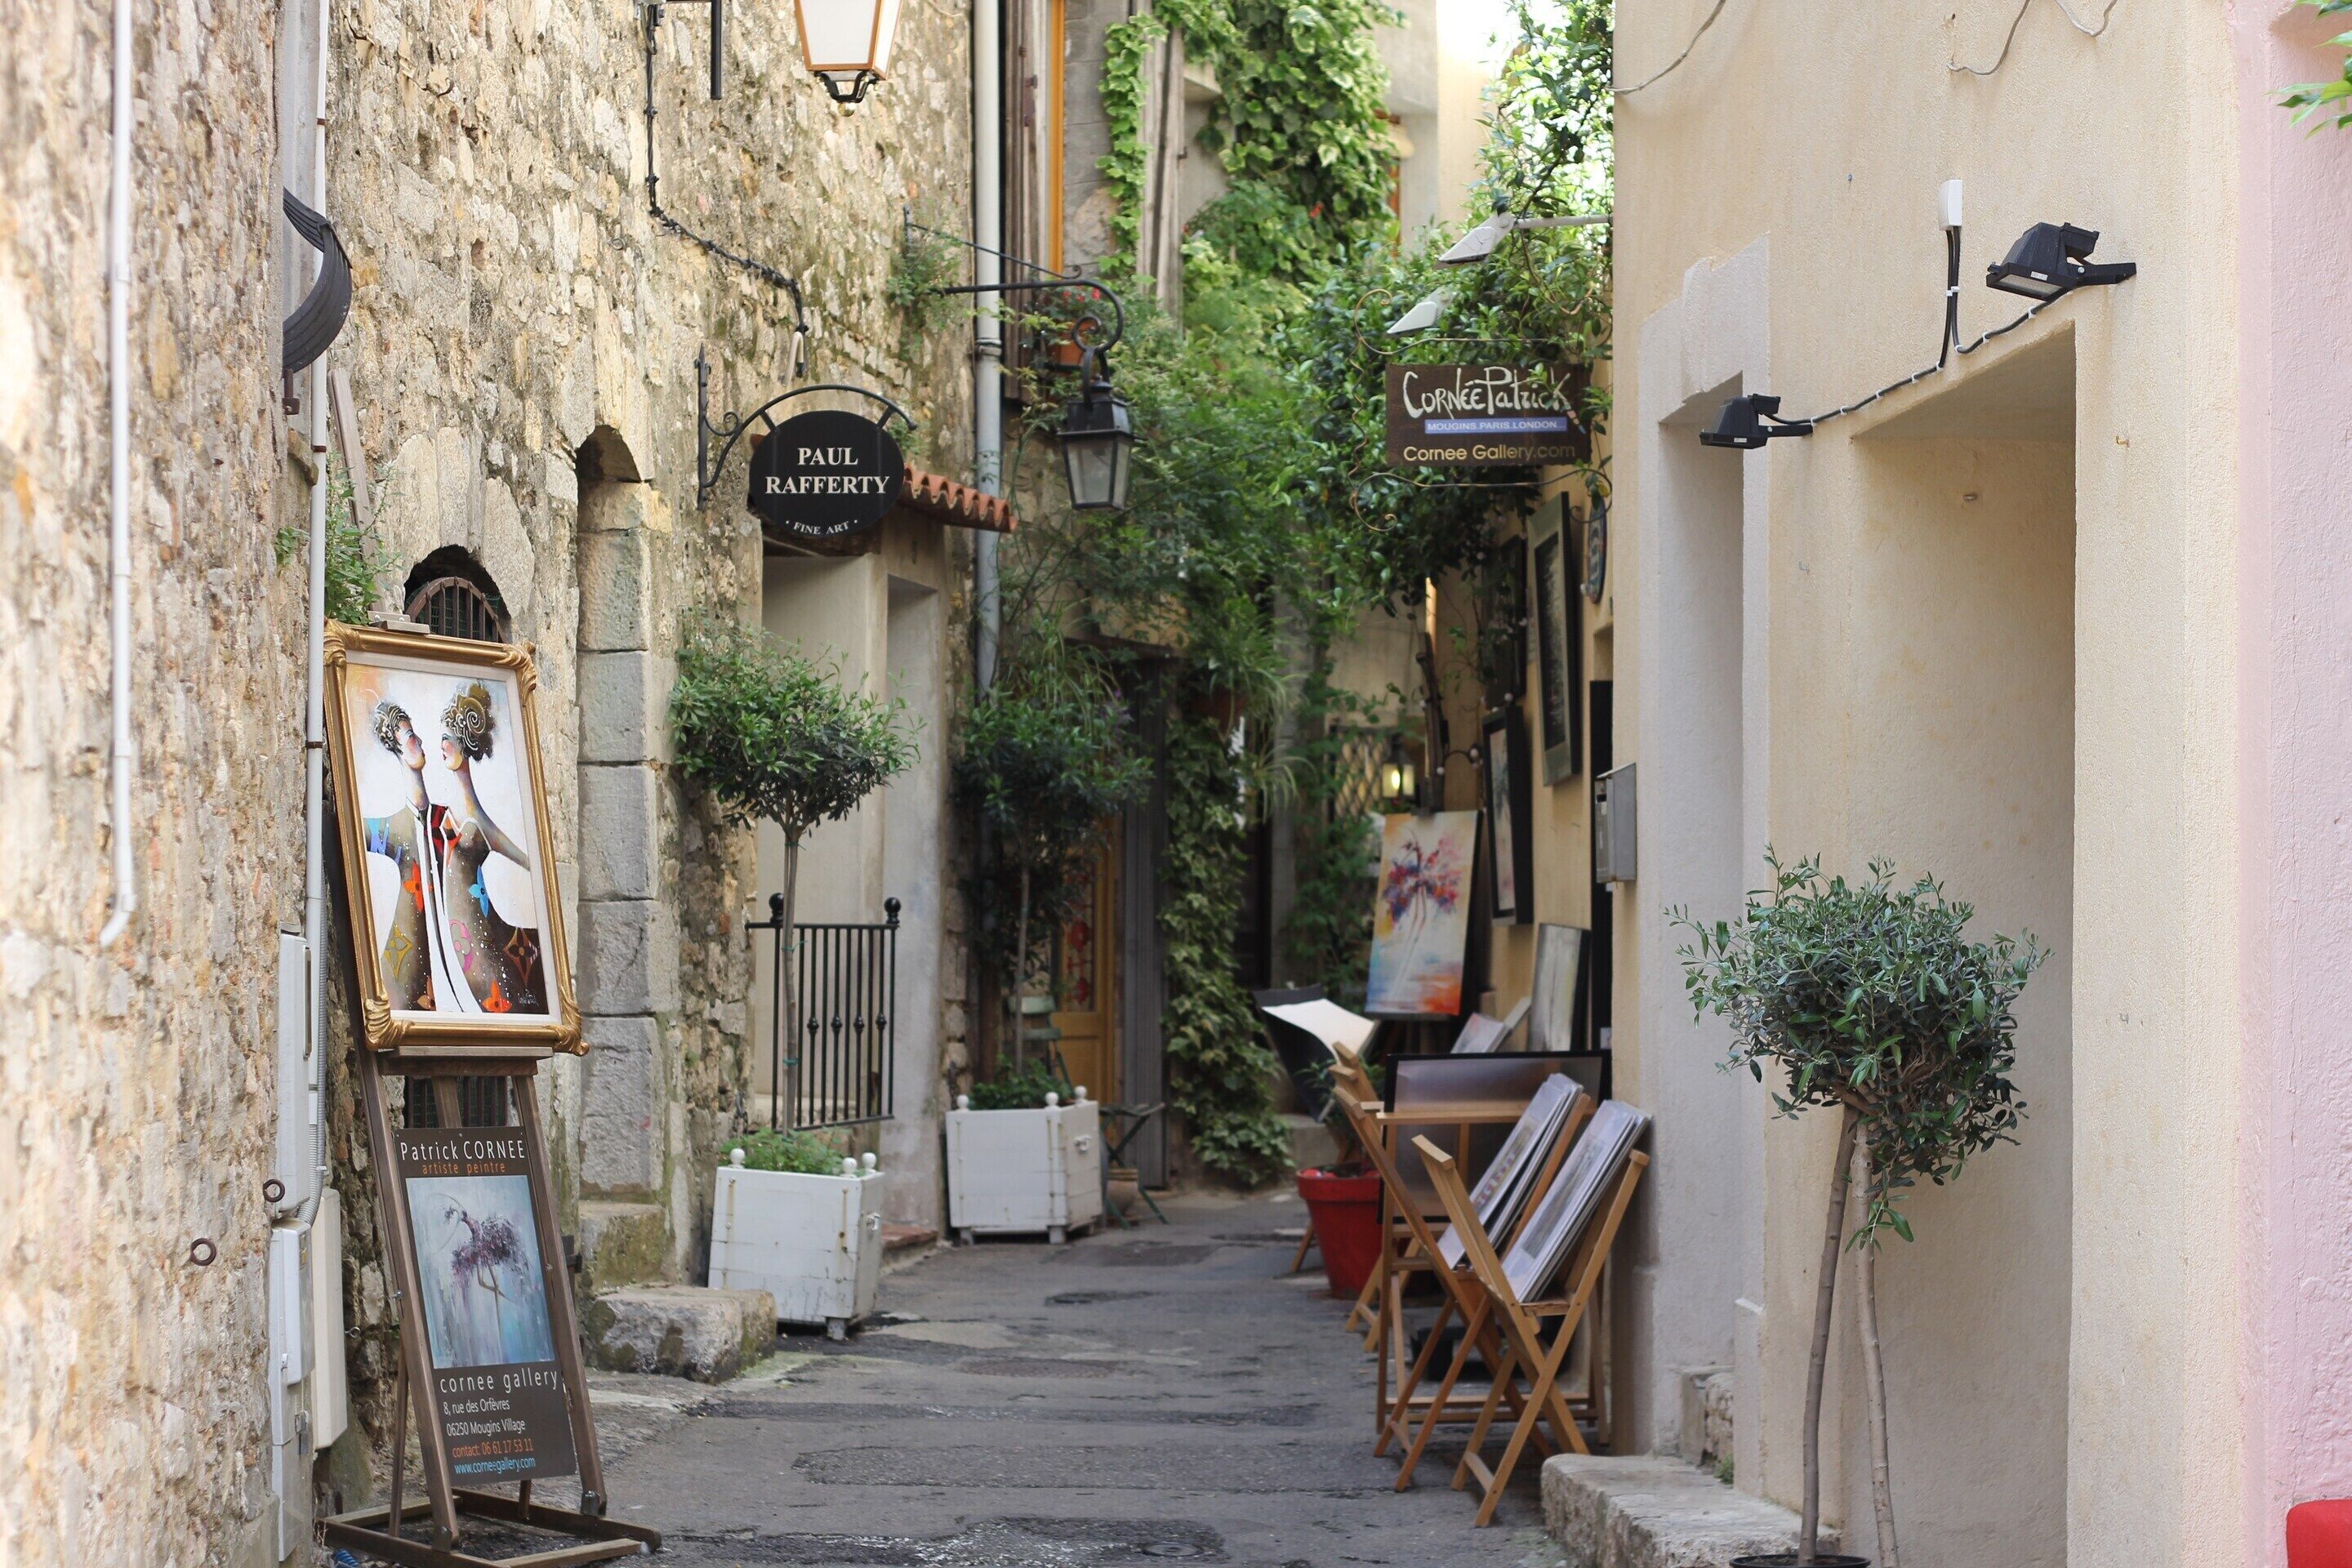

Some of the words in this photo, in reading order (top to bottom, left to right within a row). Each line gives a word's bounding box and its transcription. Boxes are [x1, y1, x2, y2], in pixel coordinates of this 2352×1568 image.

[797, 448, 858, 466] PAUL
[1403, 446, 1468, 461] Cornee
[1472, 443, 1575, 461] Gallery.com
[764, 476, 890, 494] RAFFERTY
[793, 522, 821, 535] FINE
[826, 520, 849, 535] ART
[400, 1140, 459, 1160] Patrick
[463, 1140, 525, 1159] CORNEE
[421, 1162, 459, 1175] artiste
[466, 1161, 506, 1175] peintre
[440, 1374, 494, 1393] cornee
[503, 1367, 558, 1393] gallery
[443, 1401, 451, 1416] 8,
[452, 1402, 465, 1414] rue
[466, 1400, 479, 1413] des
[480, 1397, 510, 1412] Orfèvres
[447, 1422, 469, 1437] 06250
[470, 1421, 501, 1437] Mougins
[501, 1418, 526, 1435] Village
[452, 1445, 480, 1458] contact:
[481, 1441, 491, 1454] 06
[492, 1441, 502, 1454] 61
[502, 1440, 511, 1453] 17
[513, 1439, 523, 1452] 53
[523, 1438, 534, 1451] 11
[454, 1456, 537, 1474] www.corneegallery.com
